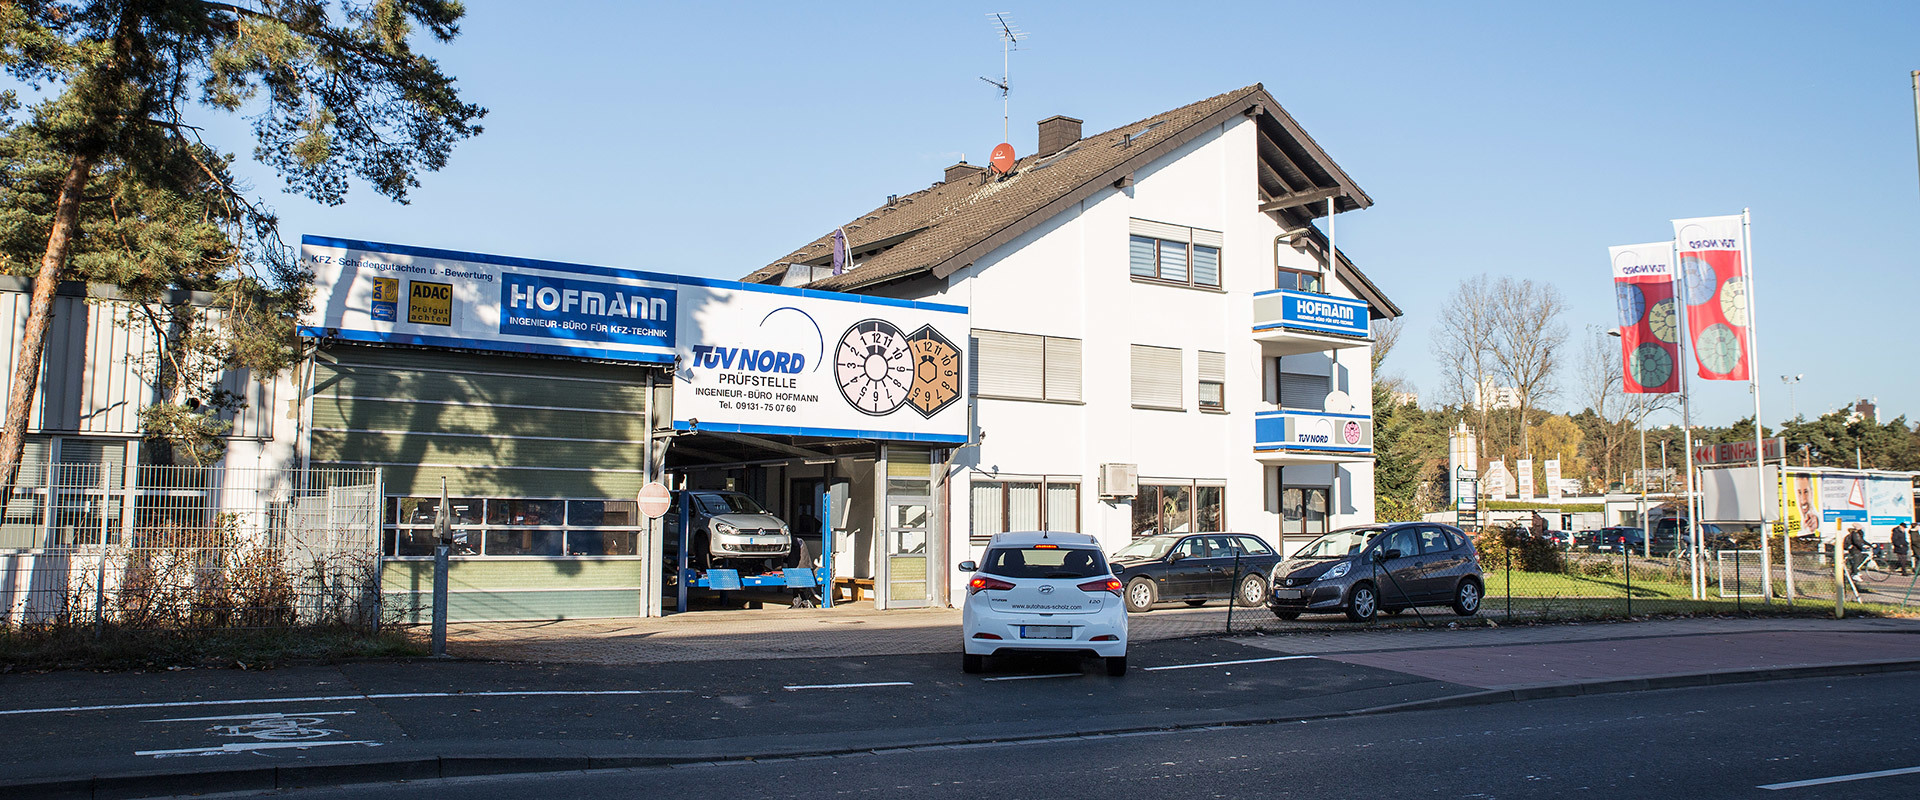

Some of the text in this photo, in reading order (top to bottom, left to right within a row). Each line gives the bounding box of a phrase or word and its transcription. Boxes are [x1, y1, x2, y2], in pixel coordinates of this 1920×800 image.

[374, 280, 382, 300] DAT
[412, 285, 448, 300] ADAC
[412, 304, 448, 314] Prüfgut
[411, 314, 448, 322] achten
[590, 323, 608, 332] FÜR
[860, 336, 867, 346] 1
[872, 333, 881, 344] 12
[884, 336, 892, 348] 11
[850, 346, 860, 356] 2
[915, 344, 920, 353] 1
[924, 342, 932, 352] 12
[934, 345, 942, 356] 11
[893, 347, 903, 360] 10
[738, 348, 806, 374] NORD
[941, 354, 951, 366] 10
[720, 372, 796, 388] PRÜFSTELLE
[893, 379, 902, 388] 8
[942, 381, 950, 390] 8
[860, 386, 868, 397] 5
[886, 388, 892, 400] 7
[913, 388, 920, 398] 5
[936, 389, 942, 400] 7
[776, 392, 818, 402] HOFMANN
[720, 400, 732, 409] Tel.
[1310, 434, 1328, 443] NORD
[1720, 440, 1776, 460] EINFAHRT
